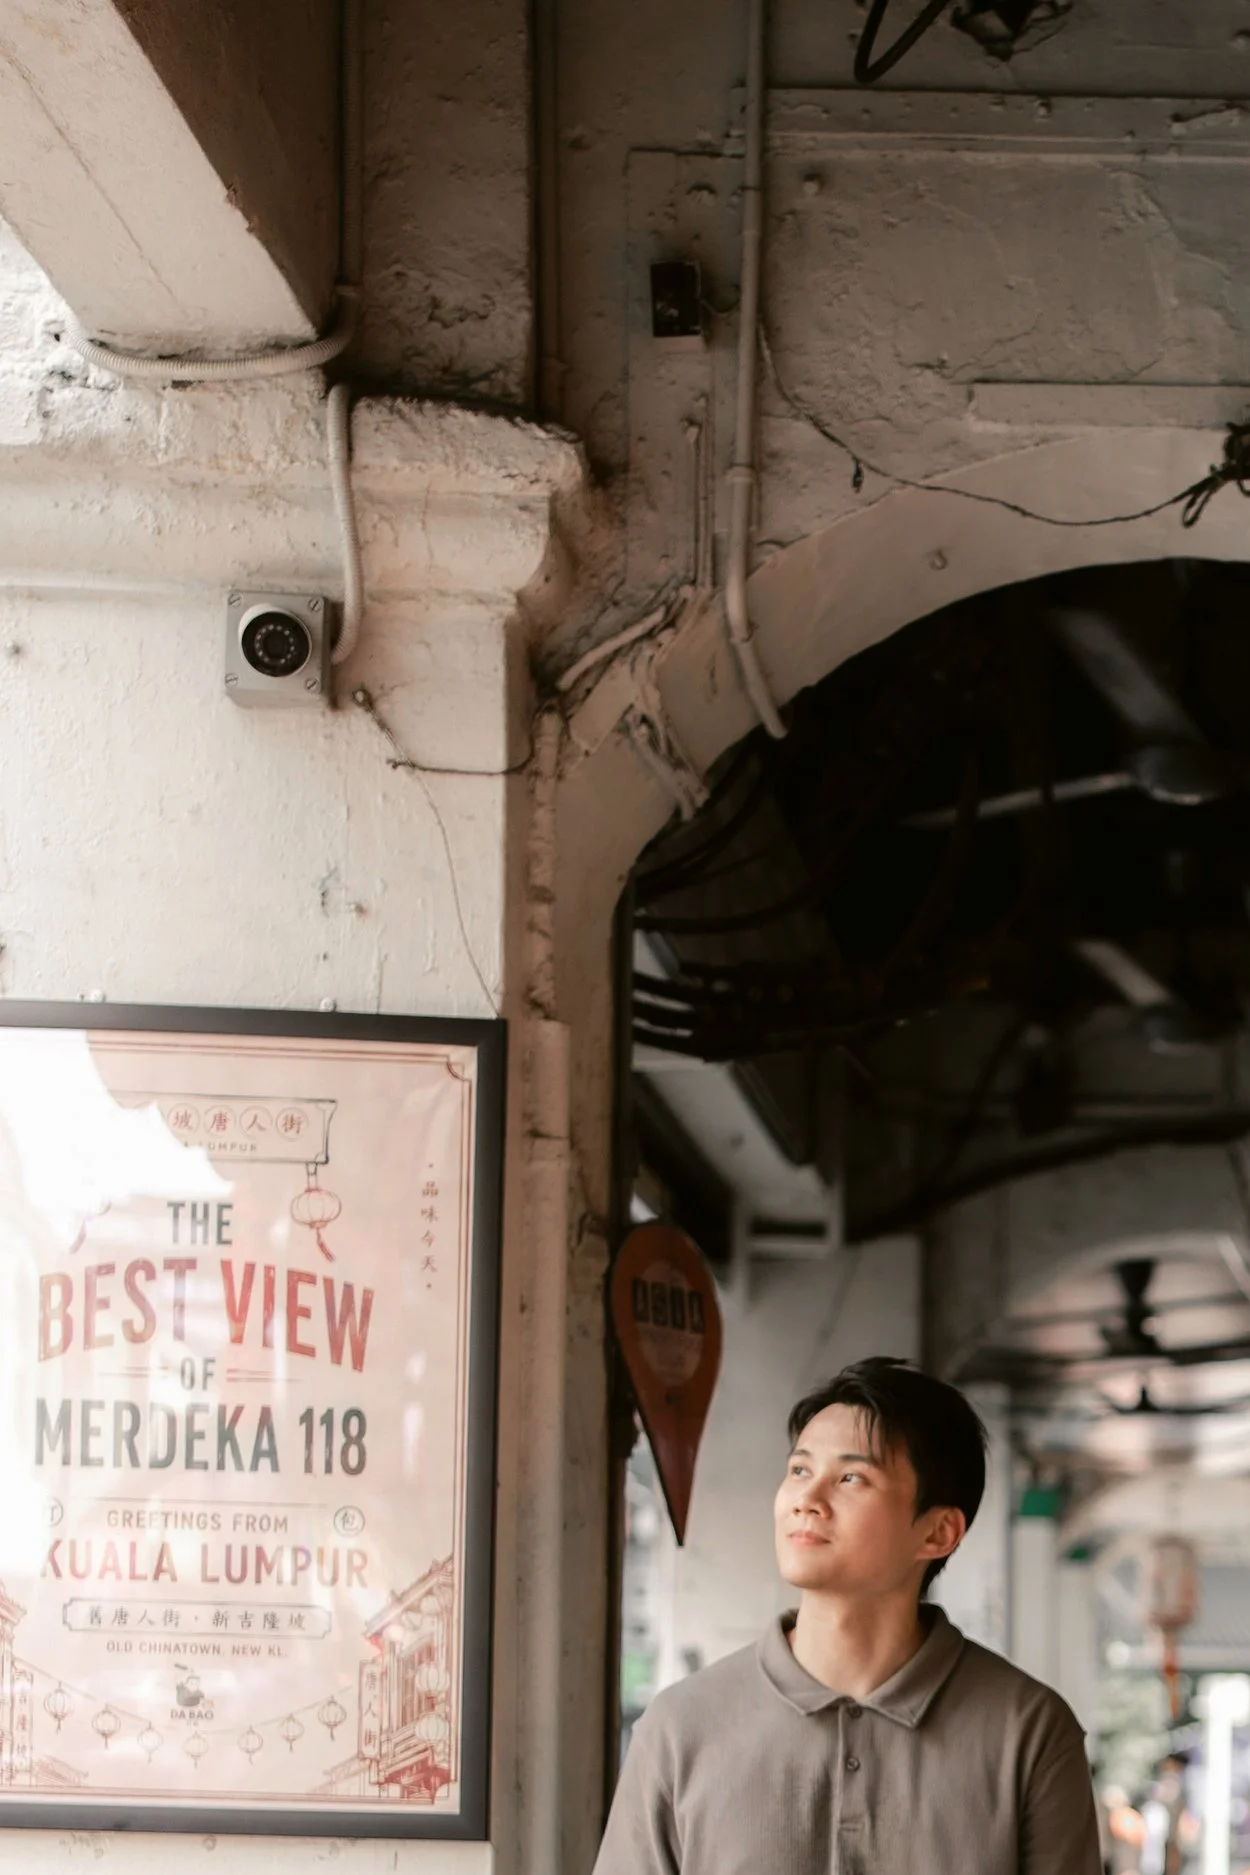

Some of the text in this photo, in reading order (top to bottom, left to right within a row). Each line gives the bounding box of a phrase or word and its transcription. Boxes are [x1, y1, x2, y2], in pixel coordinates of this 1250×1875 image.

[167, 1201, 233, 1245] THE
[38, 1258, 375, 1373] BEST VIEW
[180, 1357, 216, 1391] OF
[35, 1397, 368, 1477] MERDEKA 118
[107, 1509, 289, 1534] GREETINGS FROM
[40, 1537, 369, 1589] KUALA LUMPUR
[106, 1640, 133, 1653] OLD
[231, 1644, 262, 1657] NEW
